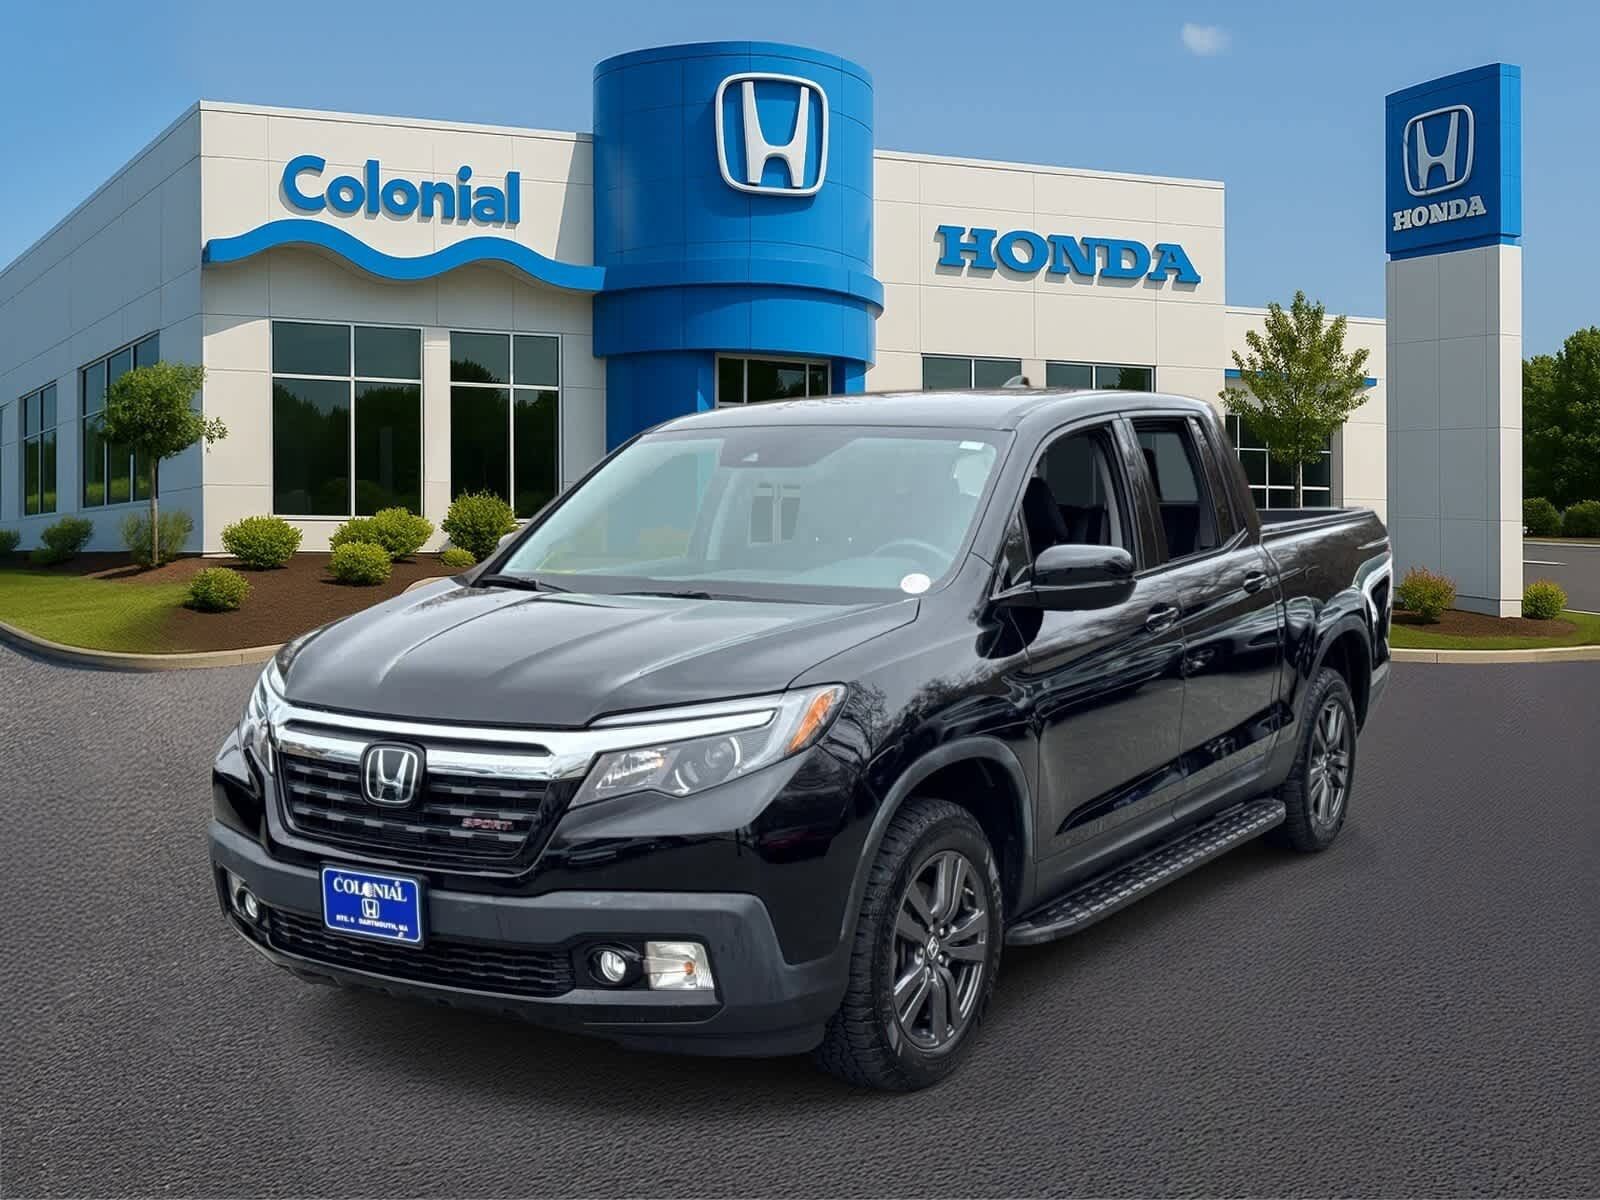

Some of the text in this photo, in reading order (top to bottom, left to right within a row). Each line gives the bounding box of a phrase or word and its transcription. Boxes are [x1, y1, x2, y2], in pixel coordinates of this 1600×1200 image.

[281, 154, 521, 226] Colonial
[1393, 195, 1487, 232] HONDA
[935, 224, 1202, 286] HONDA
[333, 877, 408, 902] COLNIAL
